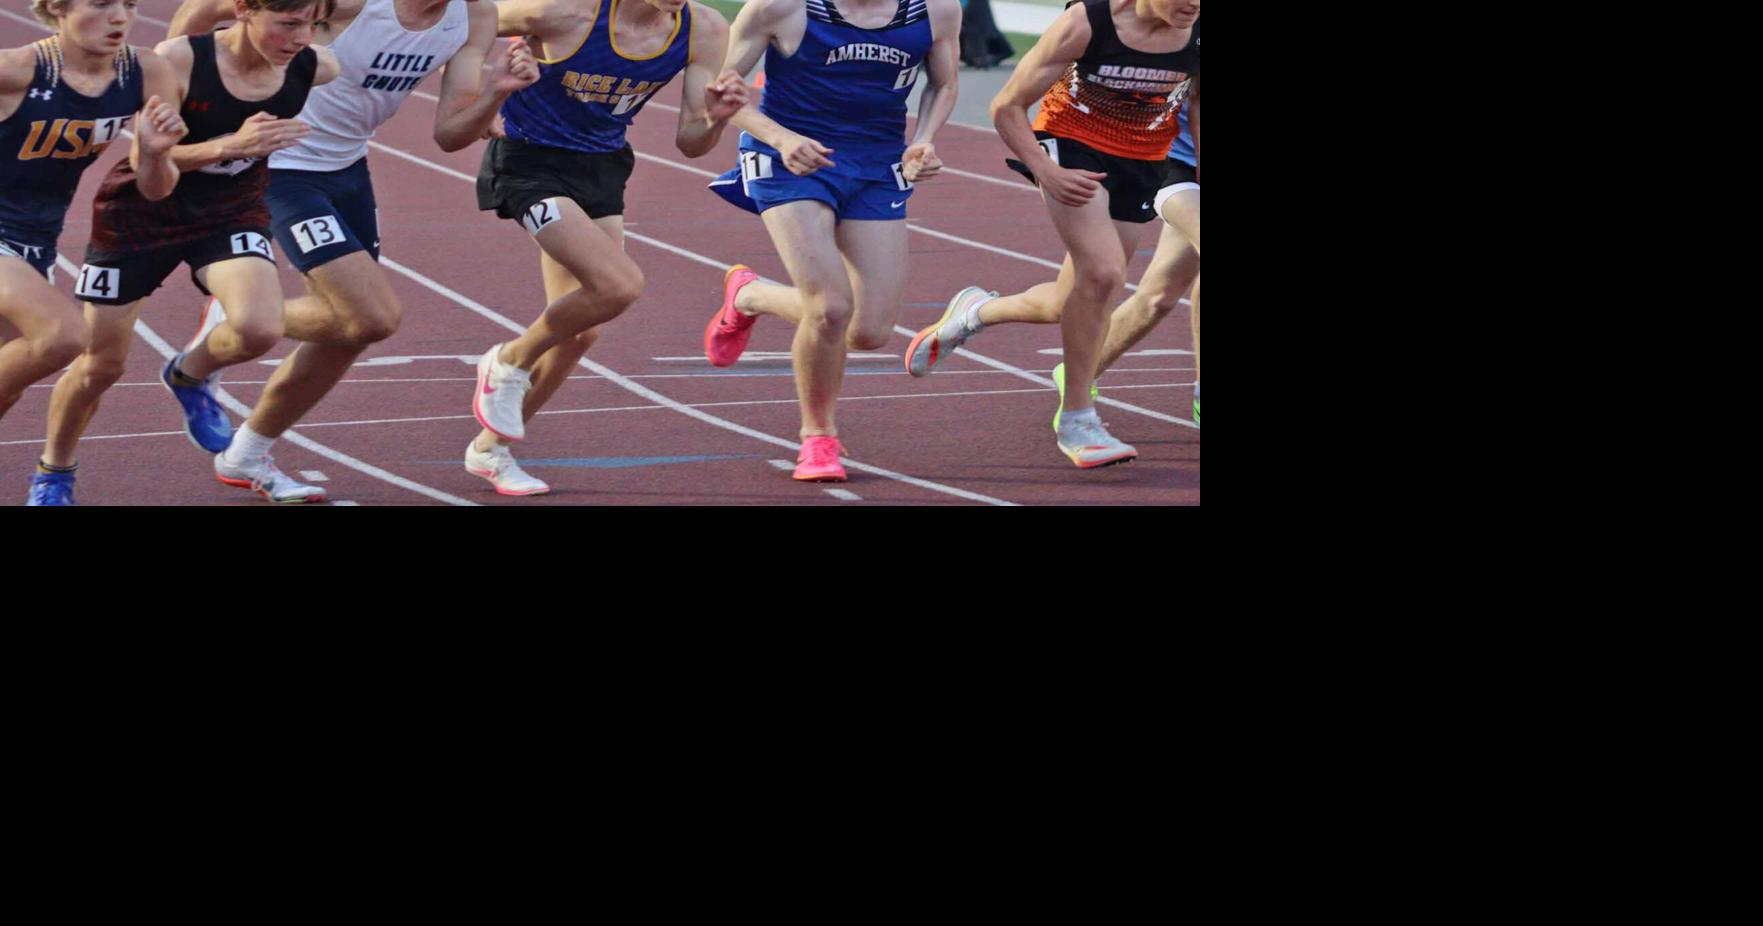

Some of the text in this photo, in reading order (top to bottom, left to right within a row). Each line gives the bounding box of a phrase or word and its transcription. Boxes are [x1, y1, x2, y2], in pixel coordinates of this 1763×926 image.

[370, 52, 435, 72] LITTLE
[825, 42, 911, 67] AMHERST
[561, 70, 618, 94] RICE
[1098, 65, 1187, 81] BLOOMER
[743, 154, 760, 180] 11
[522, 201, 553, 230] 12
[235, 233, 270, 255] 14
[300, 219, 334, 247] 13
[81, 267, 111, 296] 14
